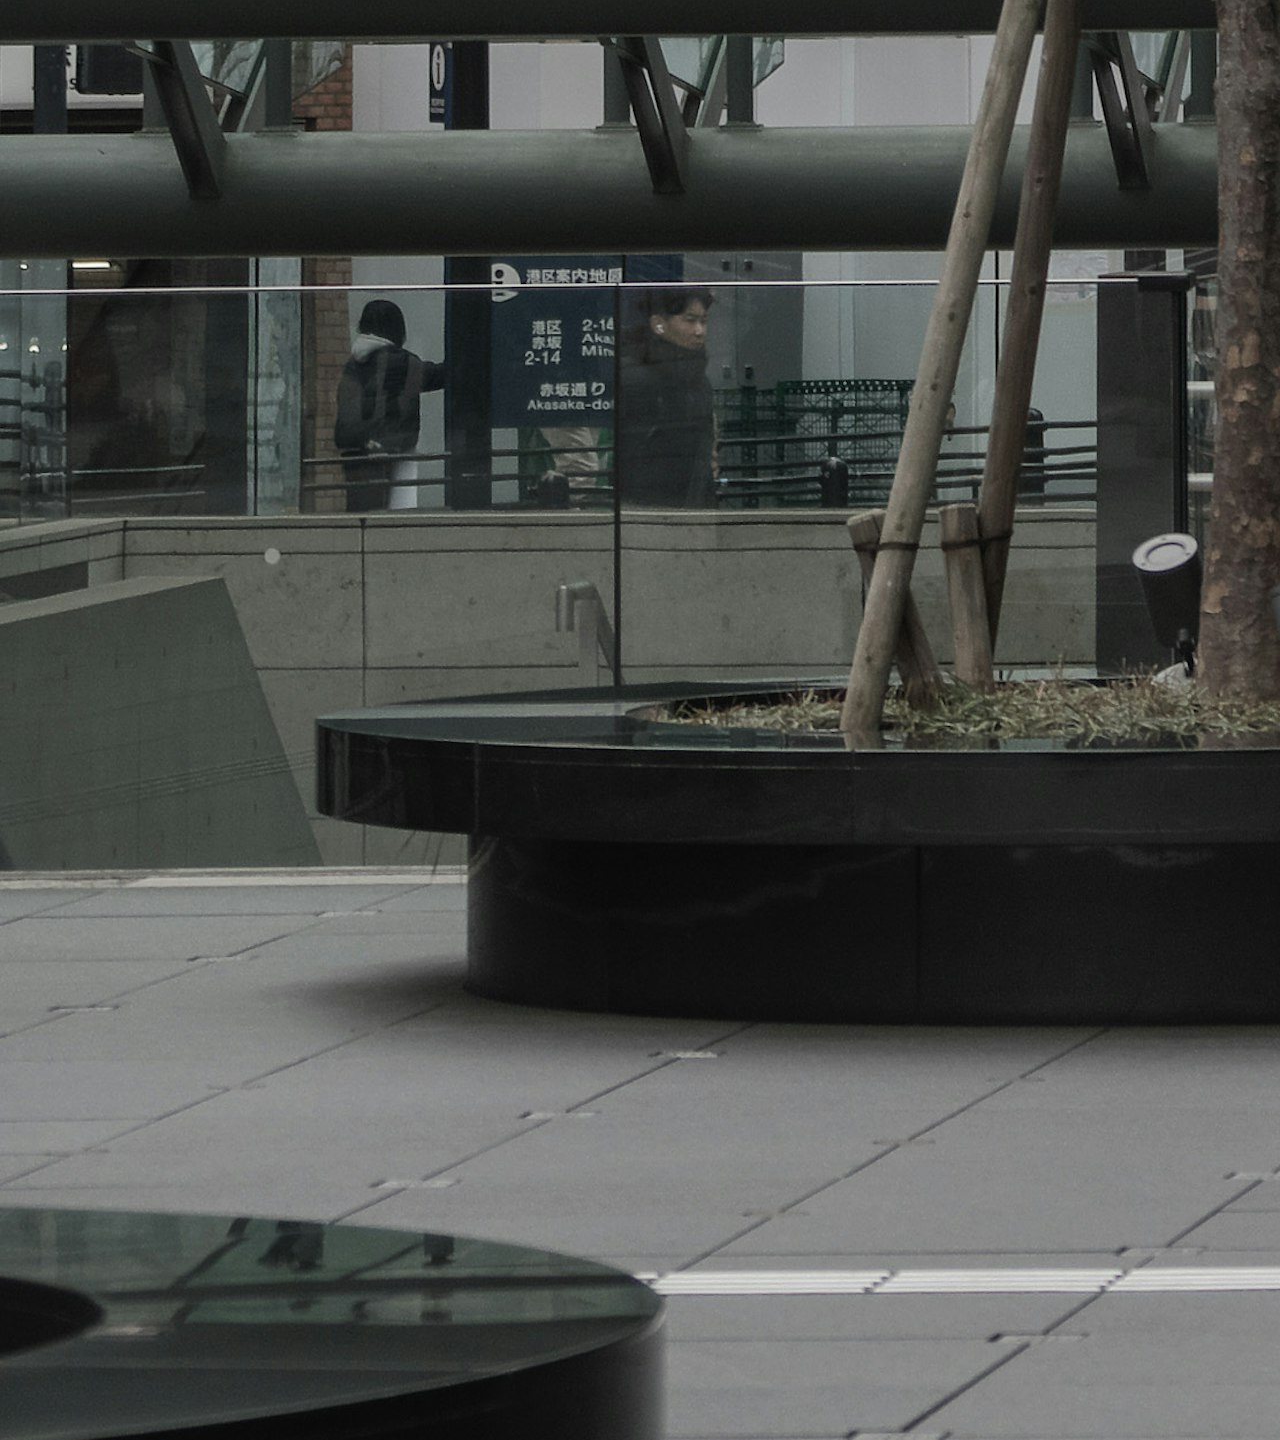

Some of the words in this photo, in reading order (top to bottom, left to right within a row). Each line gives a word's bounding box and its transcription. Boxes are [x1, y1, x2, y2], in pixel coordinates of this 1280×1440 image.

[526, 268, 623, 283] 港区案内地図
[532, 320, 562, 334] 港区
[532, 336, 562, 349] 赤坂
[525, 351, 561, 365] 2-14
[540, 382, 606, 397] 赤坂通り
